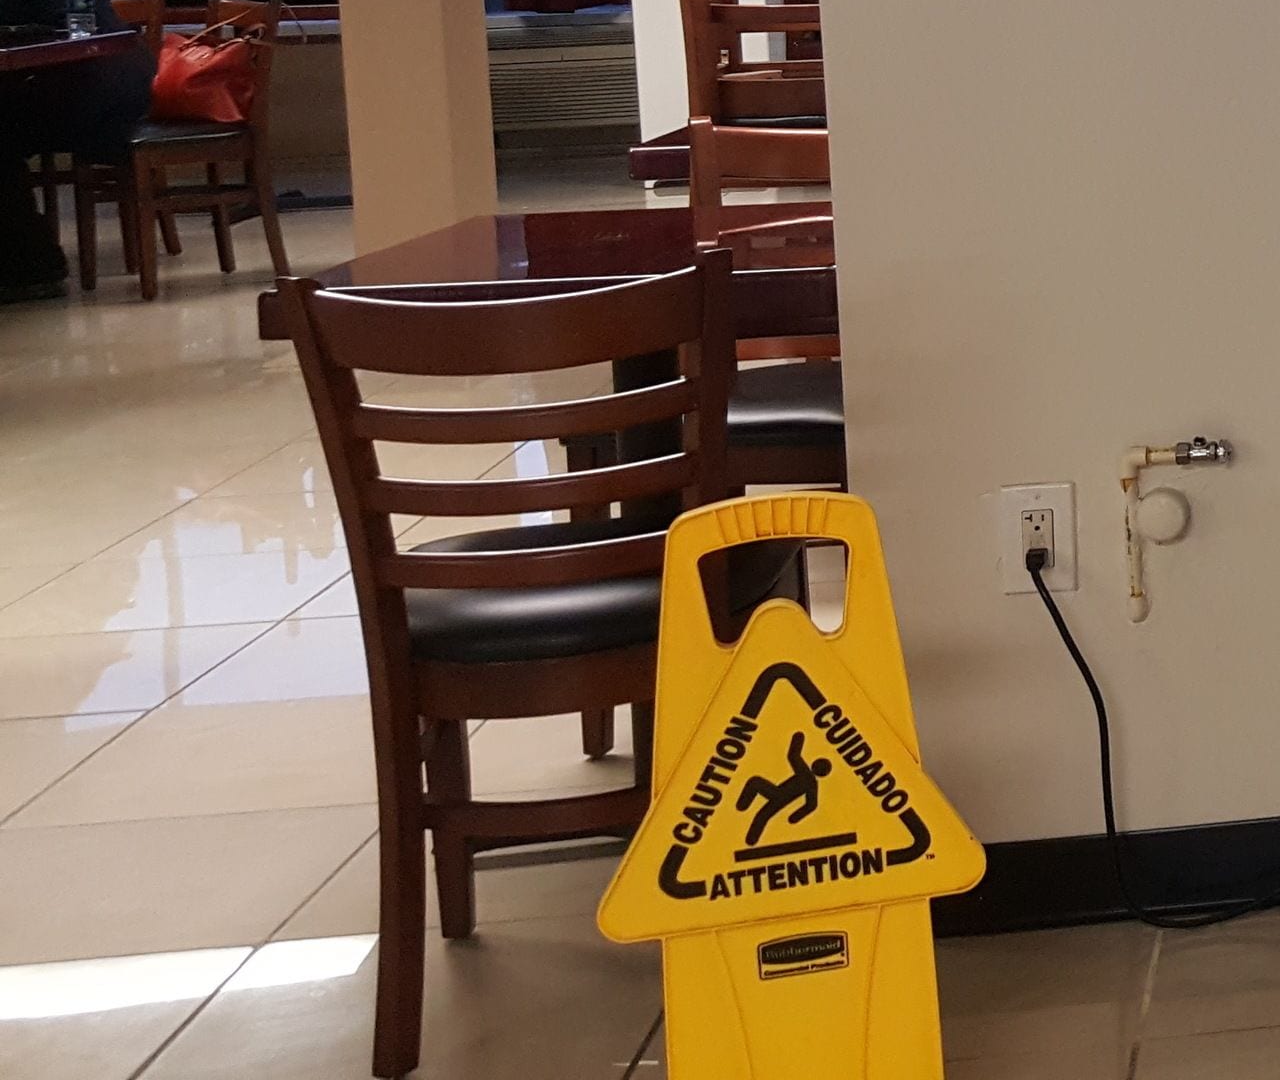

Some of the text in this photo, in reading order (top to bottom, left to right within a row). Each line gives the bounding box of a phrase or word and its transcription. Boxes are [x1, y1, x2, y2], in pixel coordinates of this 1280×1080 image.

[672, 717, 758, 843] CAUTION
[813, 703, 910, 814] CUIDADO
[709, 847, 883, 901] ATTENTION
